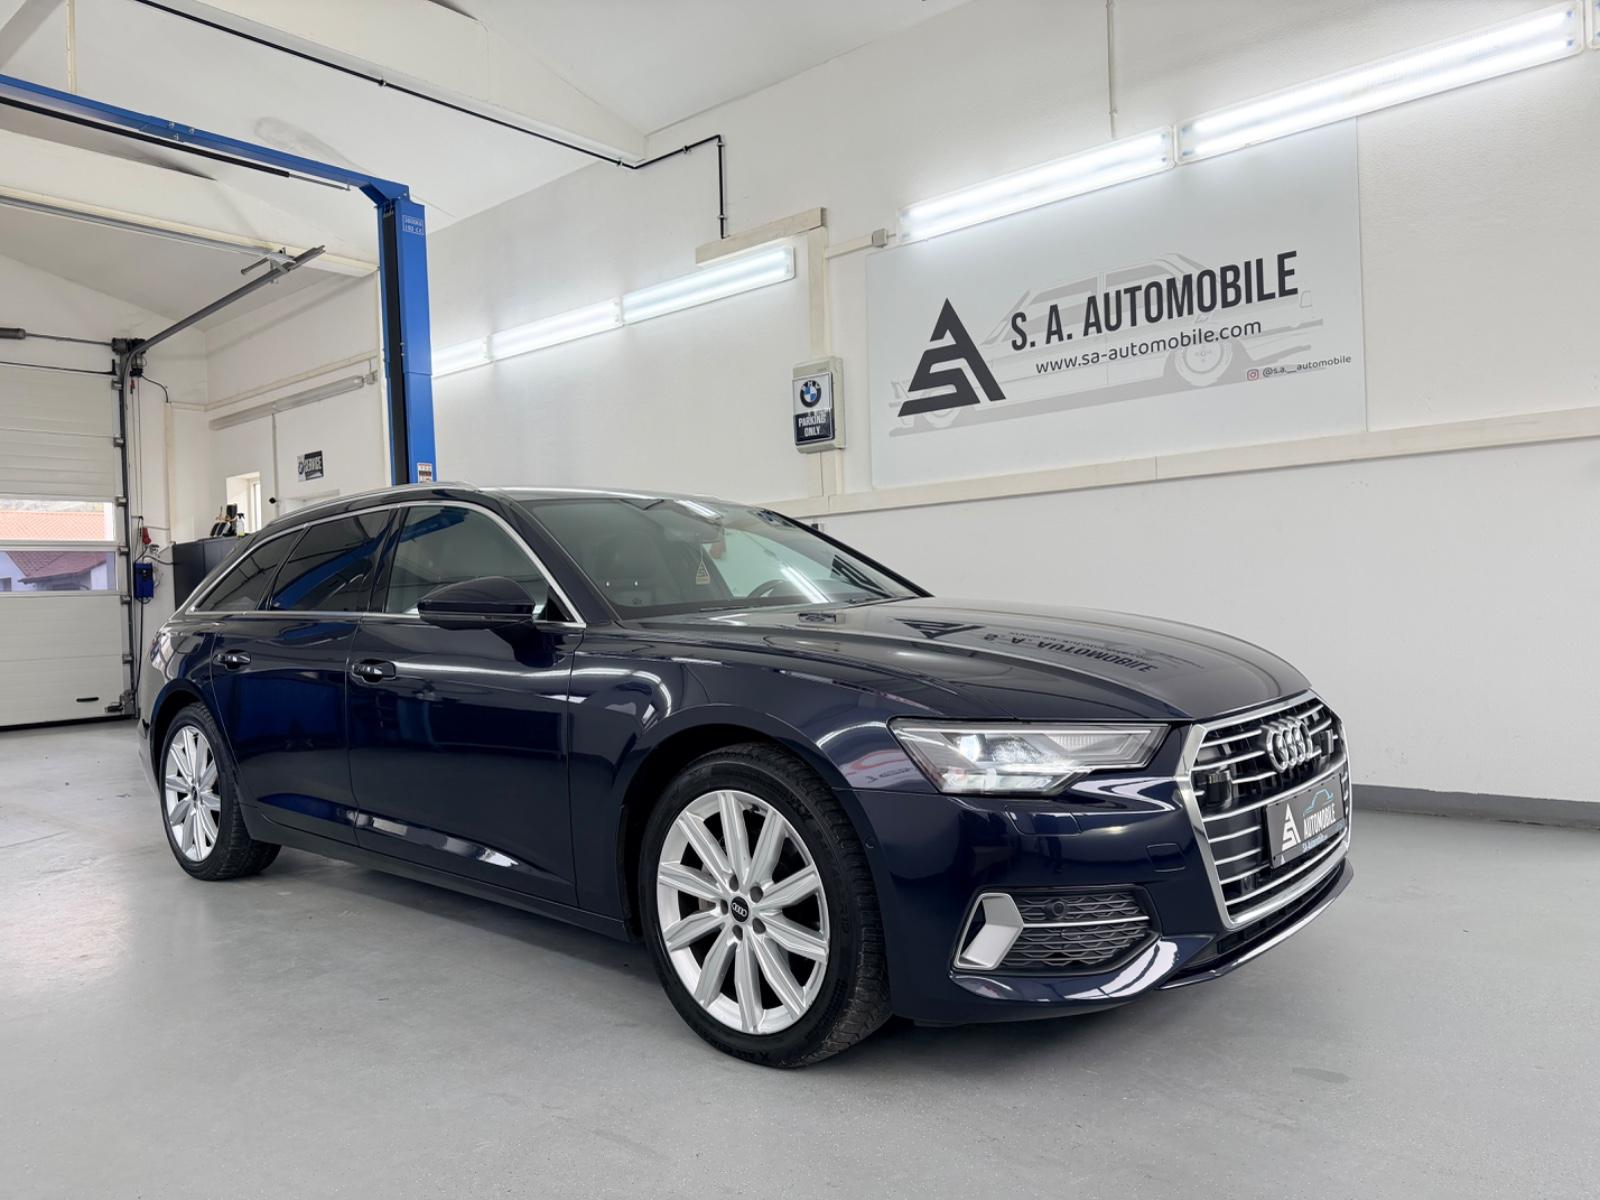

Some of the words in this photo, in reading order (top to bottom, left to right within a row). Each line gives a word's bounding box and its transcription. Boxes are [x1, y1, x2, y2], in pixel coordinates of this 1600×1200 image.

[1010, 311, 1036, 350] S.
[1045, 303, 1073, 345] A.
[1083, 250, 1299, 336] AUTOMOBILE
[1035, 318, 1262, 375] www.sa-automobile.com
[804, 426, 820, 437] ONLY
